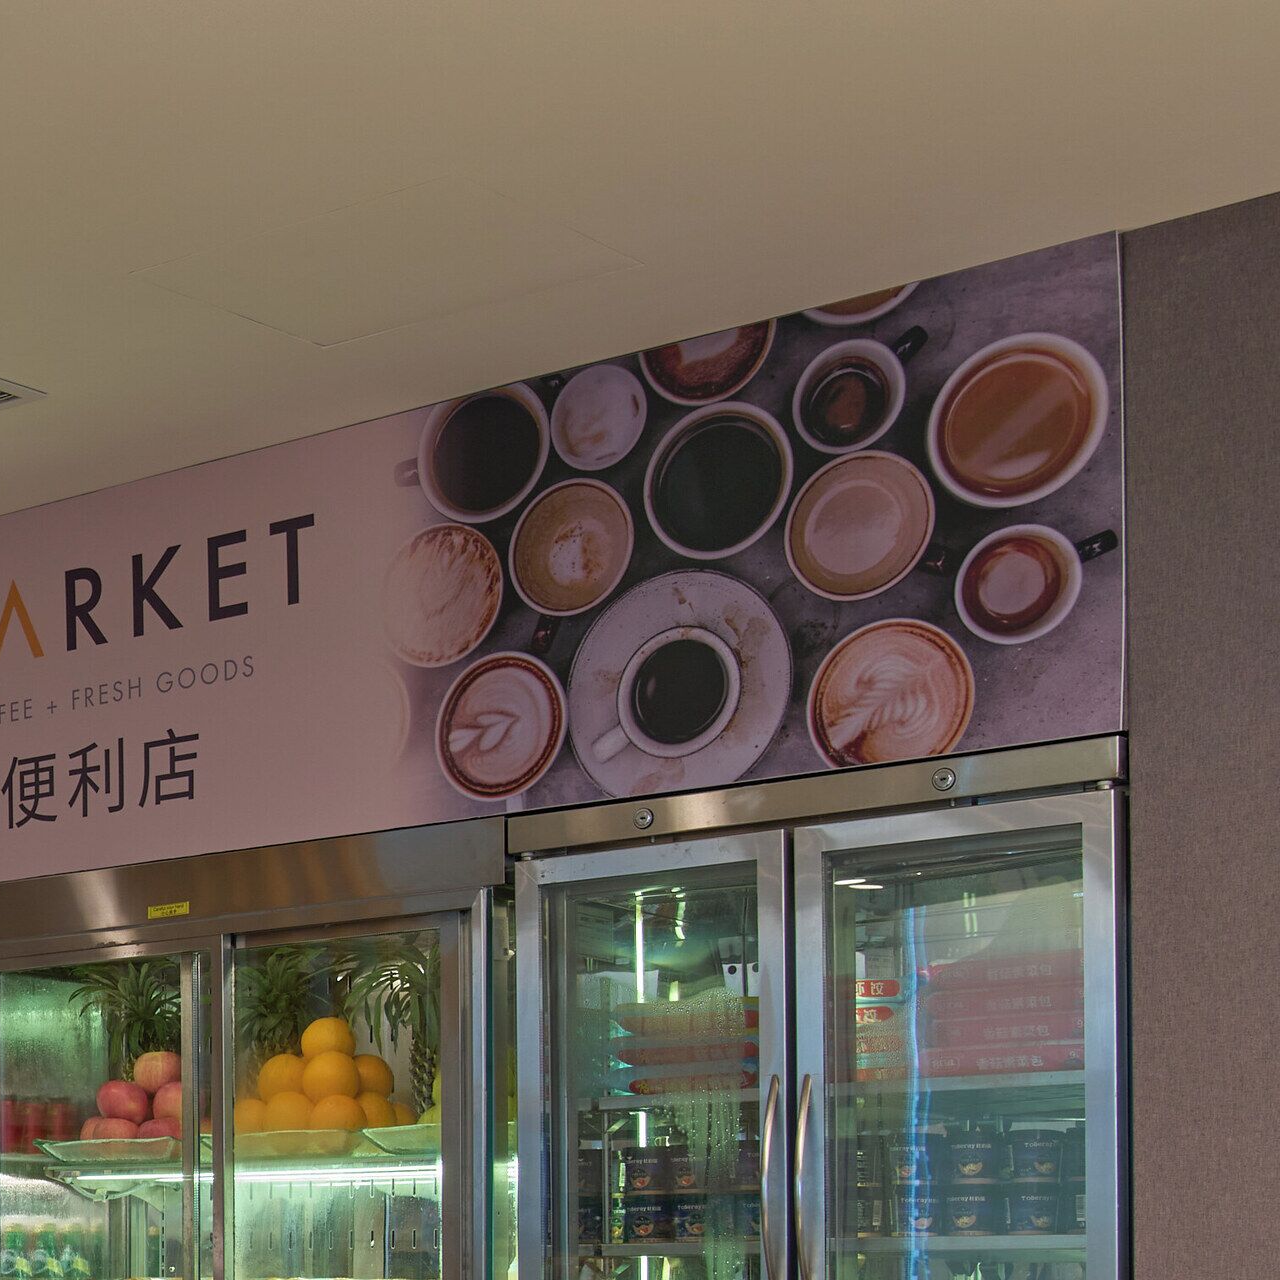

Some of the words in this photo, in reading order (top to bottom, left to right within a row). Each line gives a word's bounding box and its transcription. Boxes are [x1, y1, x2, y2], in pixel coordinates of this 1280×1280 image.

[71, 676, 142, 710] FRESH
[156, 655, 255, 694] GOODS
[1, 728, 200, 829] 便利店
